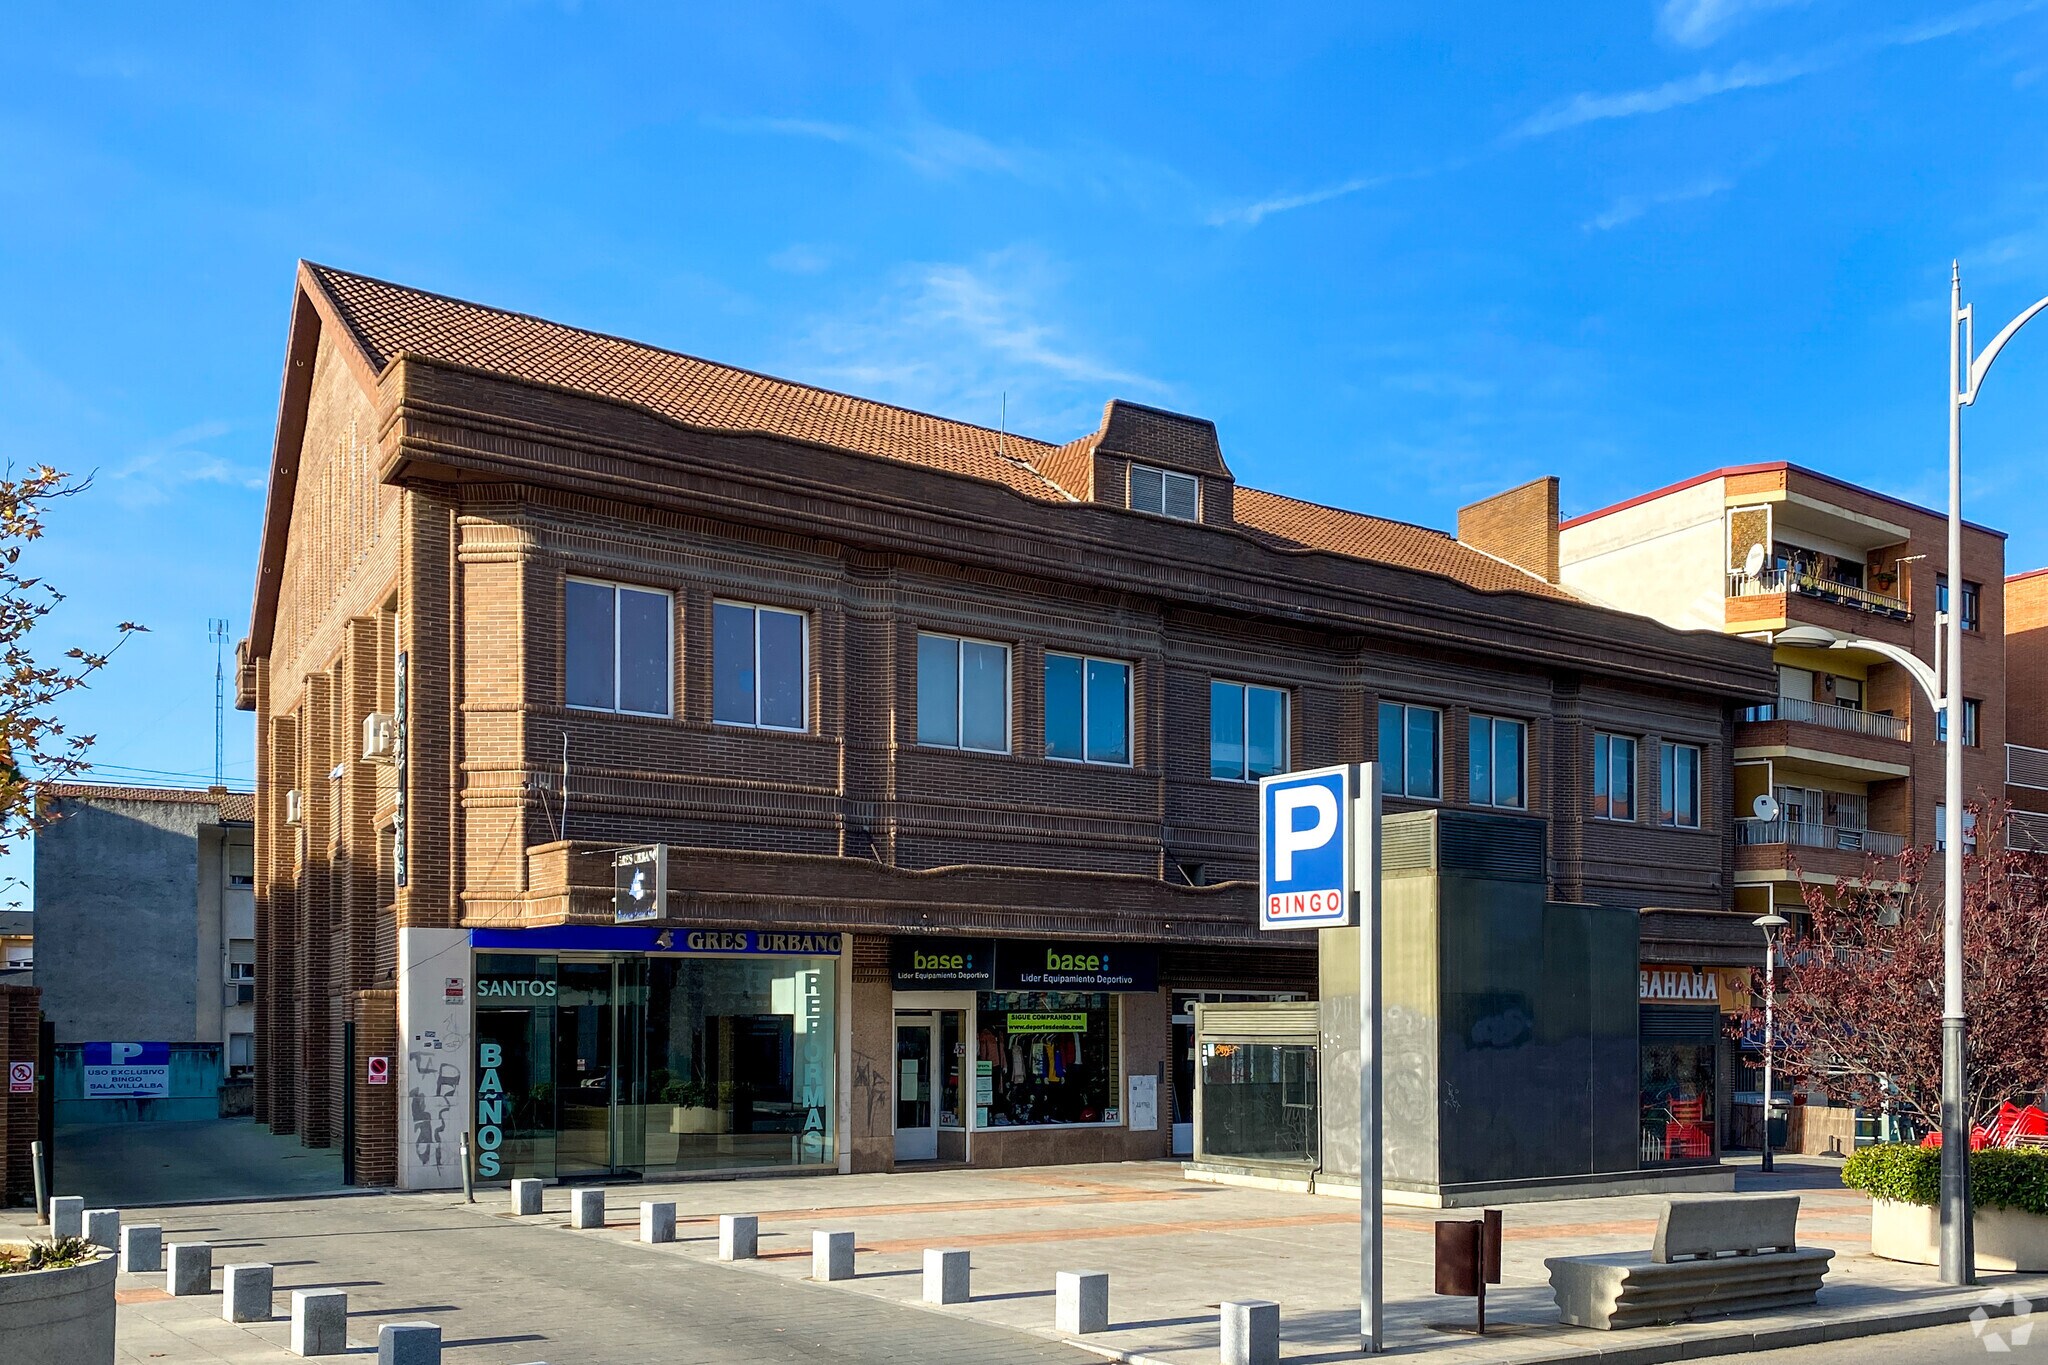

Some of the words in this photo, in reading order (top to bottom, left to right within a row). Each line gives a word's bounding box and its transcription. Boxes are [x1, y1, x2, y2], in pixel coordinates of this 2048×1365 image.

[1275, 785, 1338, 882] P
[1270, 892, 1340, 915] BINGO
[687, 932, 748, 950] GRES
[756, 934, 842, 953] URBANO
[958, 971, 989, 979] Deportivo
[1043, 974, 1095, 984] Equipamiento
[1096, 975, 1133, 985] Deportivo
[1640, 970, 1718, 999] SAHARA
[477, 980, 556, 997] SANTOS
[111, 1042, 143, 1065] P
[477, 1043, 503, 1178] BAÑOS
[1106, 1111, 1118, 1120] 2x1
